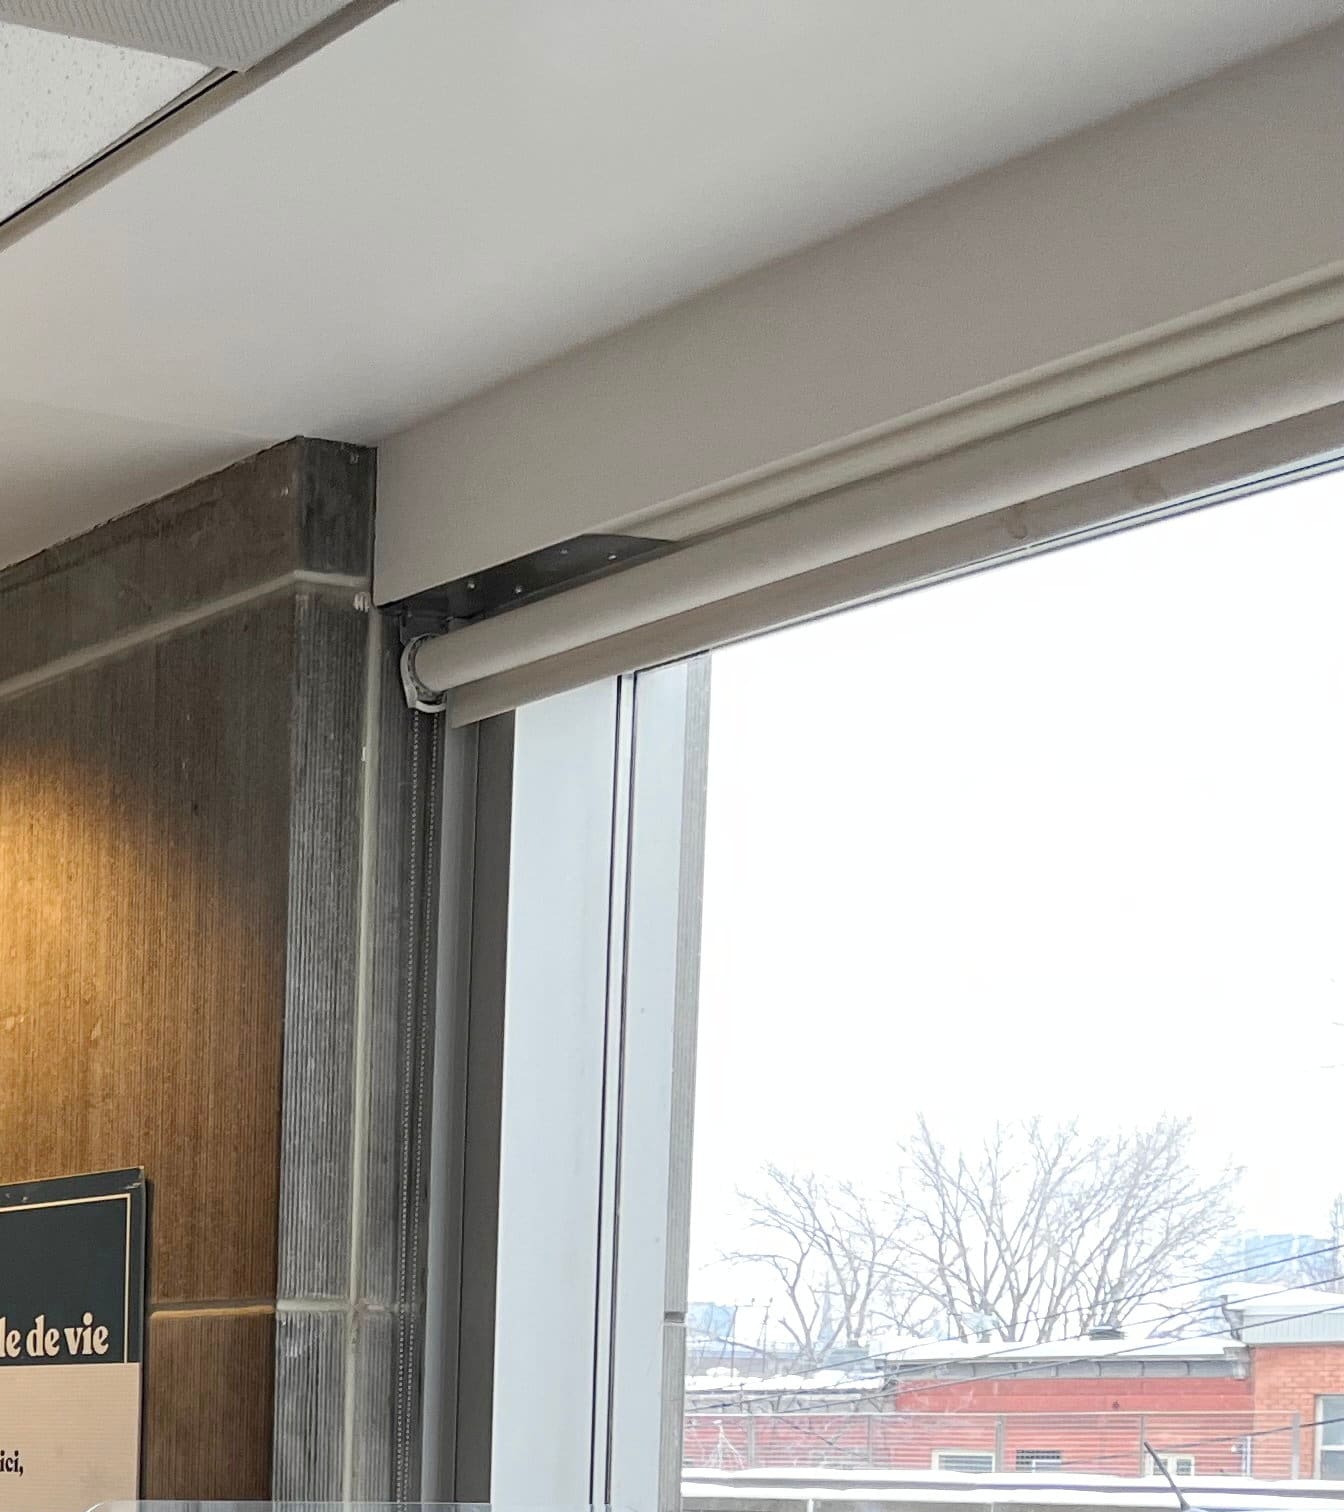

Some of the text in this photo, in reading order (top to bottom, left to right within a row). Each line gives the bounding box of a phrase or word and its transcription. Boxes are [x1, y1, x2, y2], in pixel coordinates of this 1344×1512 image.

[26, 1313, 60, 1357] de
[65, 1311, 110, 1356] vie
[0, 1450, 25, 1478] ici,
